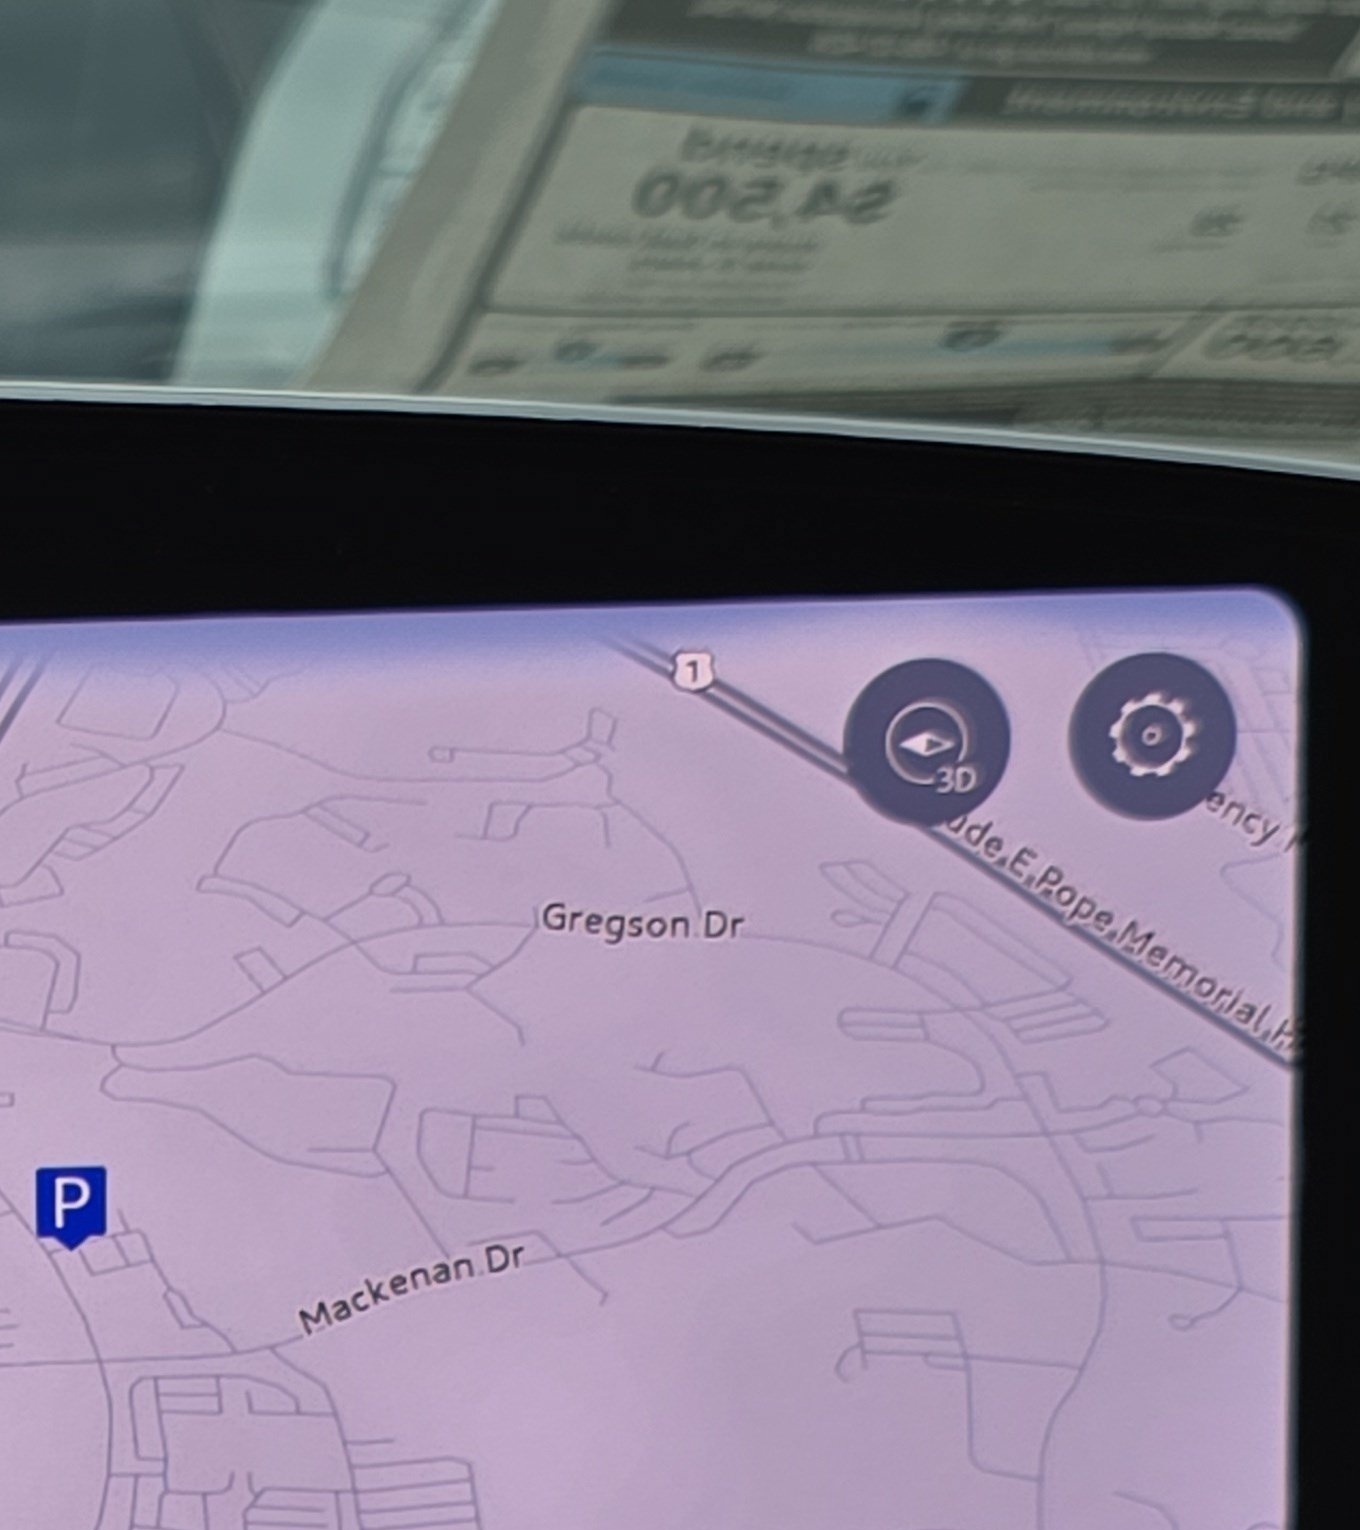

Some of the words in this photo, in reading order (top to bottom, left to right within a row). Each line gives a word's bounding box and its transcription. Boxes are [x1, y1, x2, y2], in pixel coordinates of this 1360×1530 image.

[684, 659, 699, 683] 1
[934, 766, 977, 793] 3D
[542, 901, 691, 946] Gregson
[704, 908, 746, 939] Dr
[1009, 846, 1039, 880] E
[1035, 864, 1115, 935] Pope
[1118, 919, 1272, 1033] Memorial
[53, 1175, 92, 1230] P
[297, 1257, 476, 1336] Mackenan
[484, 1243, 526, 1275] Dr
